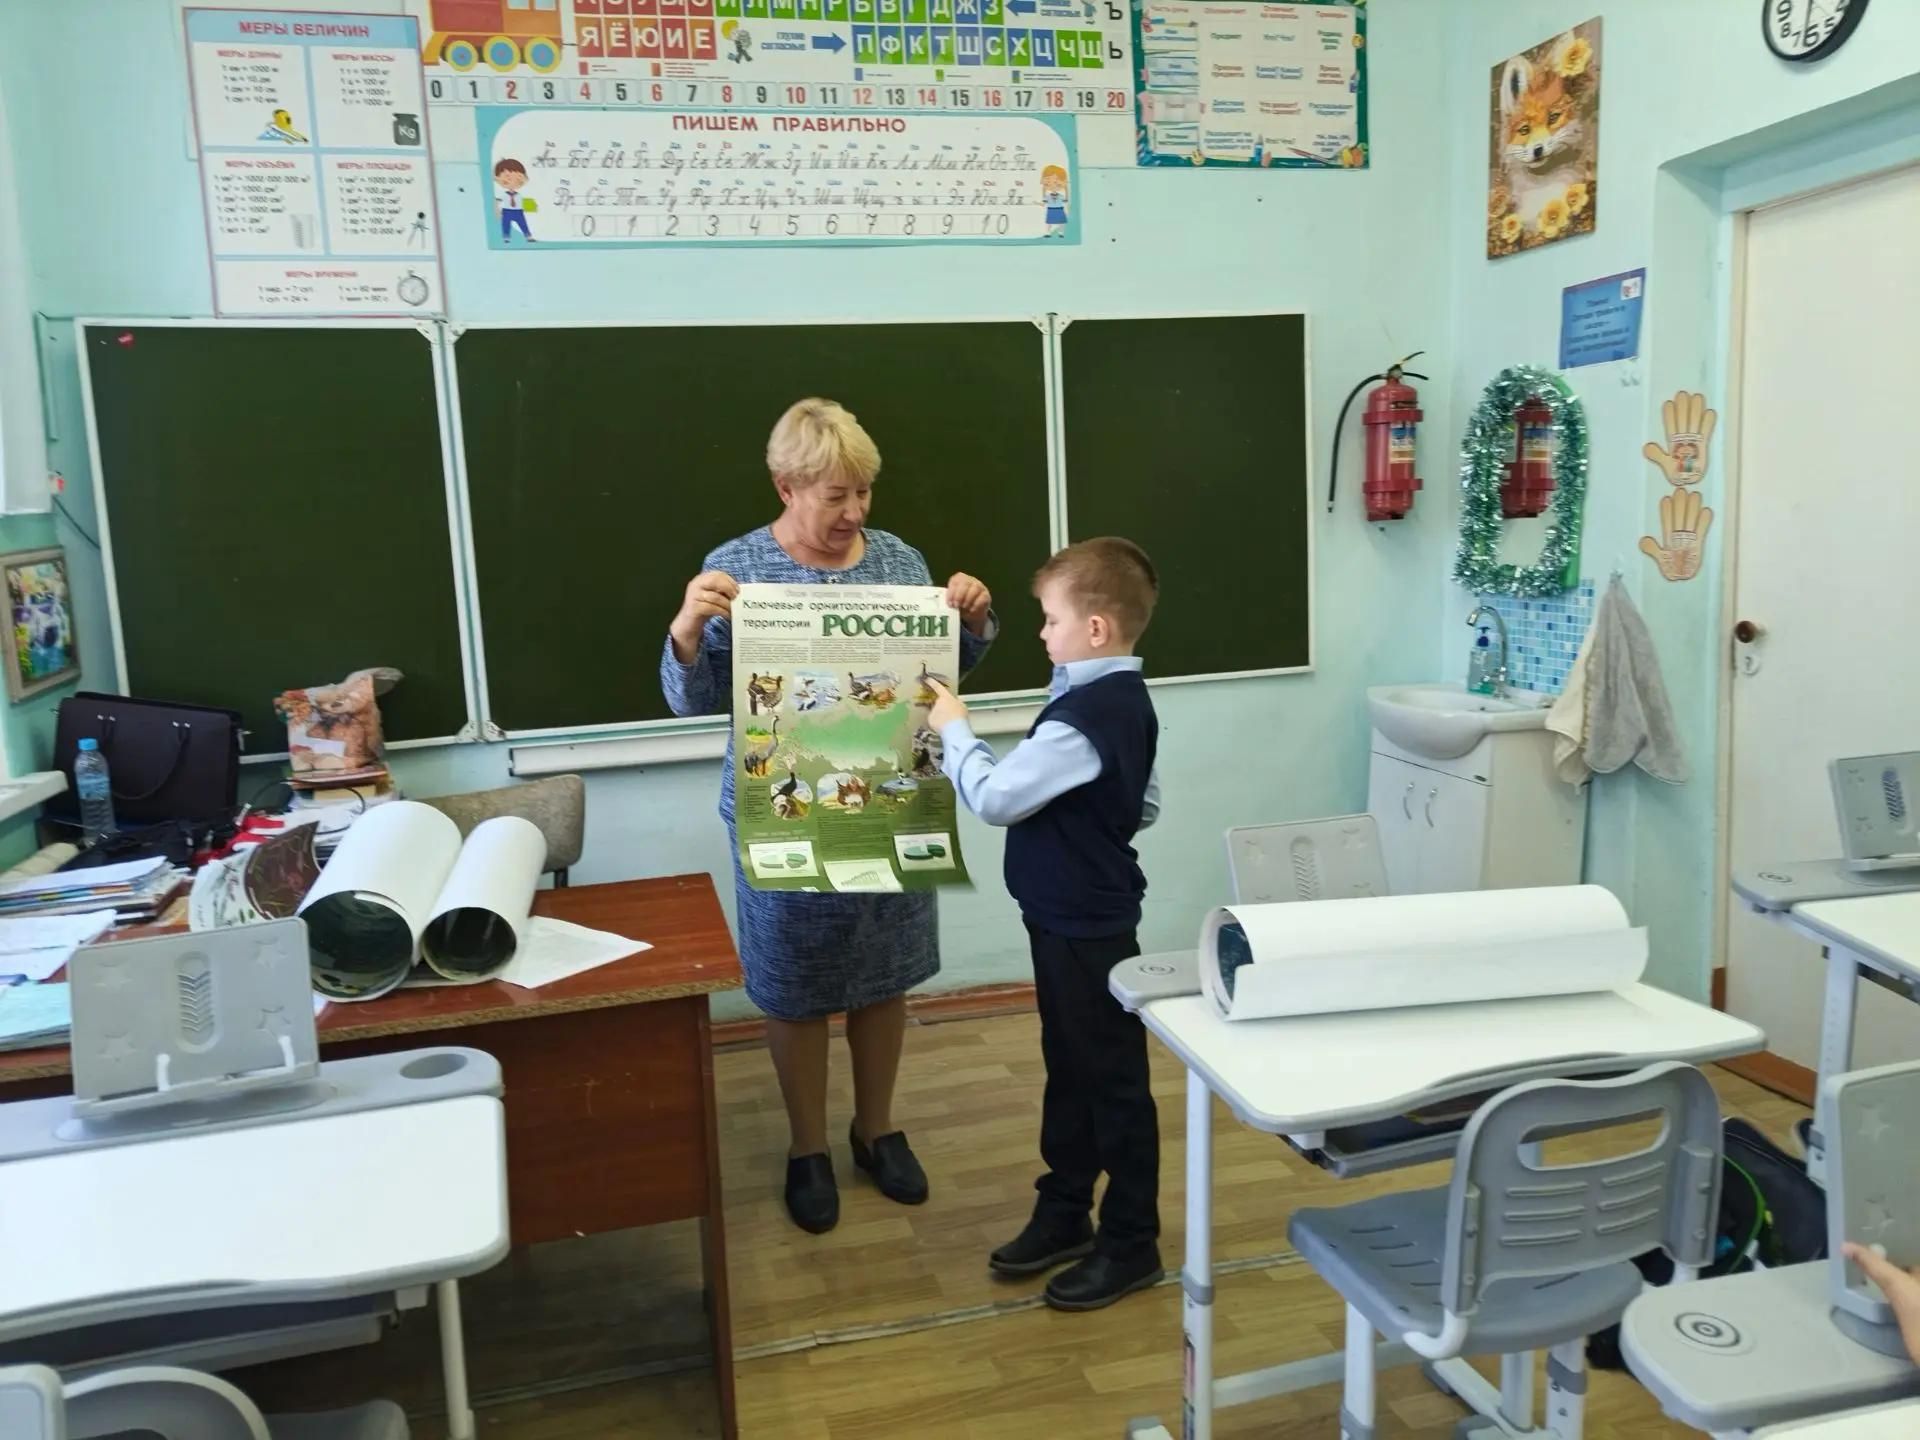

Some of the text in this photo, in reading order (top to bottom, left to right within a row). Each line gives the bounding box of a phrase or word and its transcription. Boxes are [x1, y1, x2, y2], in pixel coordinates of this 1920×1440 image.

[932, 0, 950, 18] Д
[956, 0, 977, 14] Ж
[985, 0, 999, 15] З
[239, 21, 370, 38] МЕРЫ ВЕЛИЧИН
[581, 21, 712, 49] Я Ё Ю И Е
[1781, 22, 1791, 38] 8
[1803, 23, 1819, 47] 6
[856, 34, 873, 53] П
[881, 34, 900, 54] Ф
[909, 35, 924, 54] К
[934, 36, 950, 54] Т
[957, 35, 979, 55] Ш
[985, 36, 1002, 55] С
[1011, 37, 1028, 56] Х
[1035, 38, 1053, 60] Ц
[1060, 39, 1076, 58] Ч
[430, 80, 1126, 109] 0 1 2 3 4 5 6 7 8 9 10 11 12 13 14 15 16 17 18 19 20
[672, 115, 906, 132] ПИШЕМ ПРАВИЛЬНО
[581, 214, 1010, 237] 0 1 2 3 4 5 6 7 8 9 10
[743, 599, 921, 614] Ключевые орнитологические
[744, 613, 950, 638] территории РОССИИ
